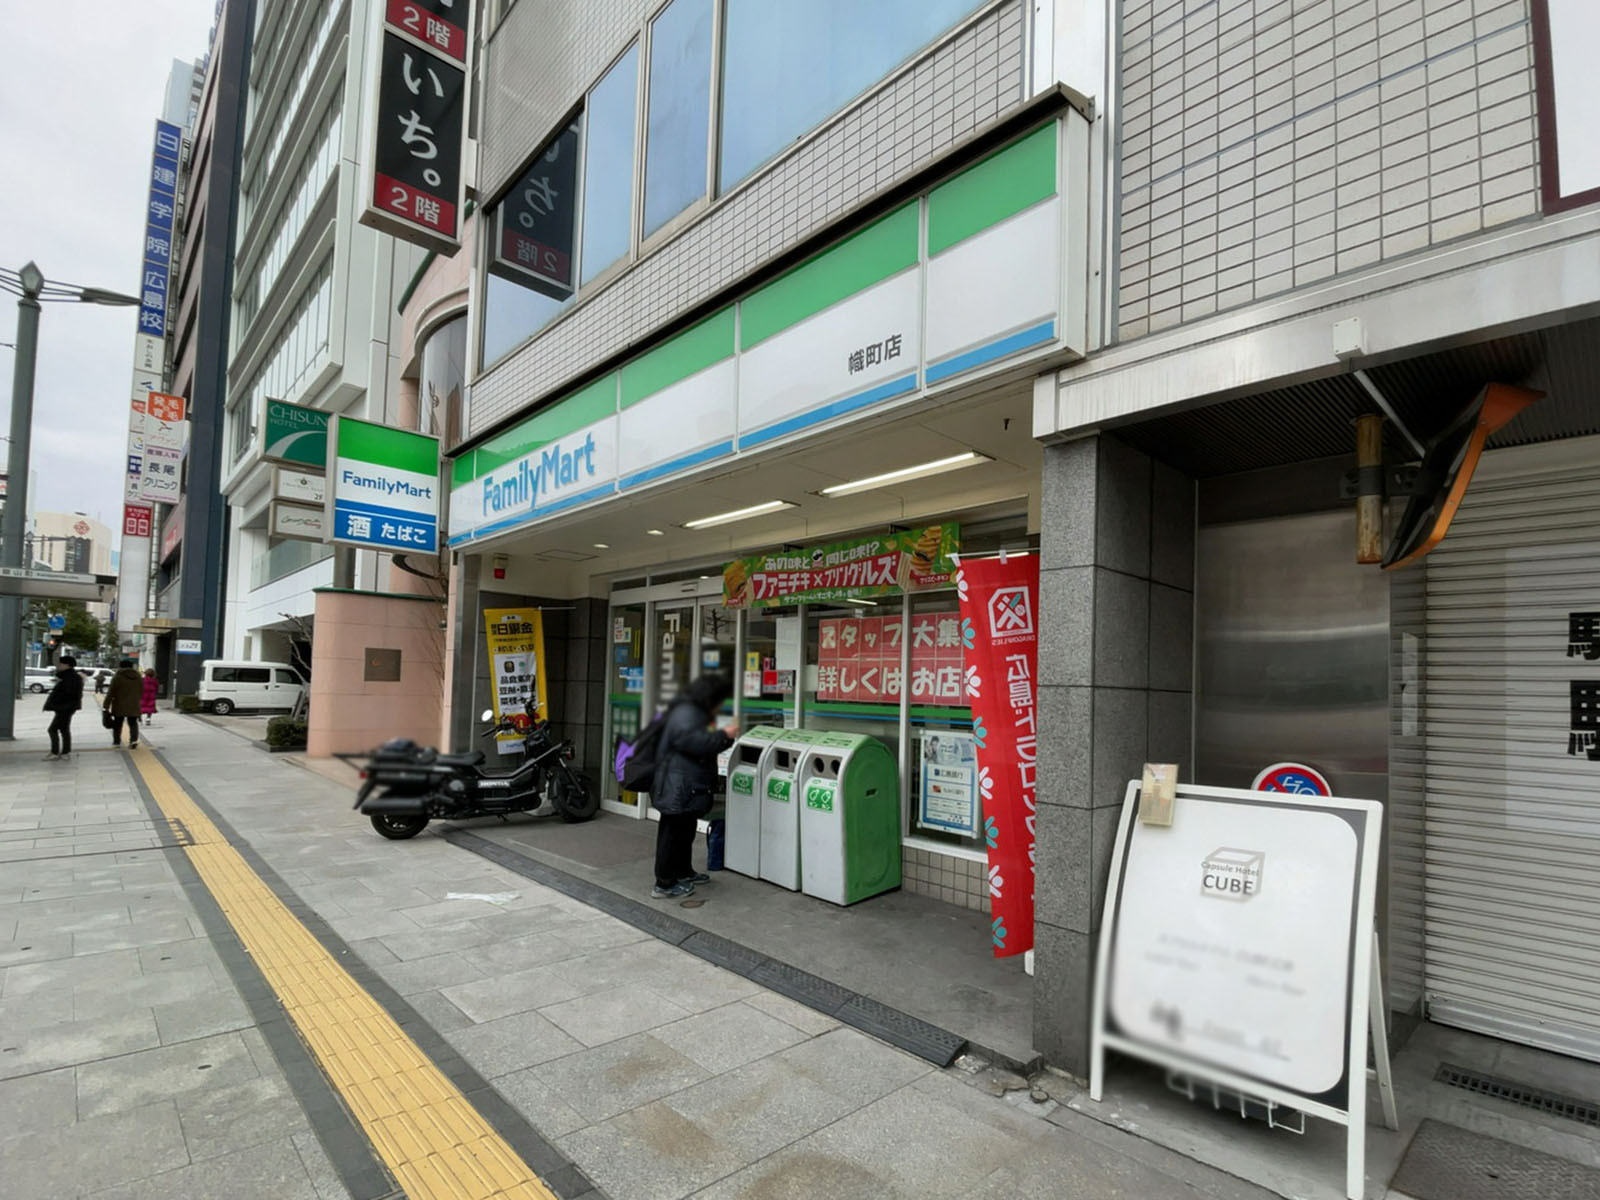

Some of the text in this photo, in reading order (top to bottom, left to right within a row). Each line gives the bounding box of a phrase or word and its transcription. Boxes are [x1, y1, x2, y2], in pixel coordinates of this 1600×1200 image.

[402, 6, 450, 49] 2階
[390, 187, 440, 225] 2階
[848, 333, 902, 375] 幟町店
[144, 477, 178, 490] クリニック
[343, 471, 431, 499] FamilyMart
[483, 433, 596, 516] FamilyMart
[347, 515, 371, 539] 酒
[381, 523, 426, 543] たばこ
[765, 557, 809, 571] あの味と
[818, 664, 968, 699] 詳しくはお店
[1203, 874, 1254, 896] CUBE
